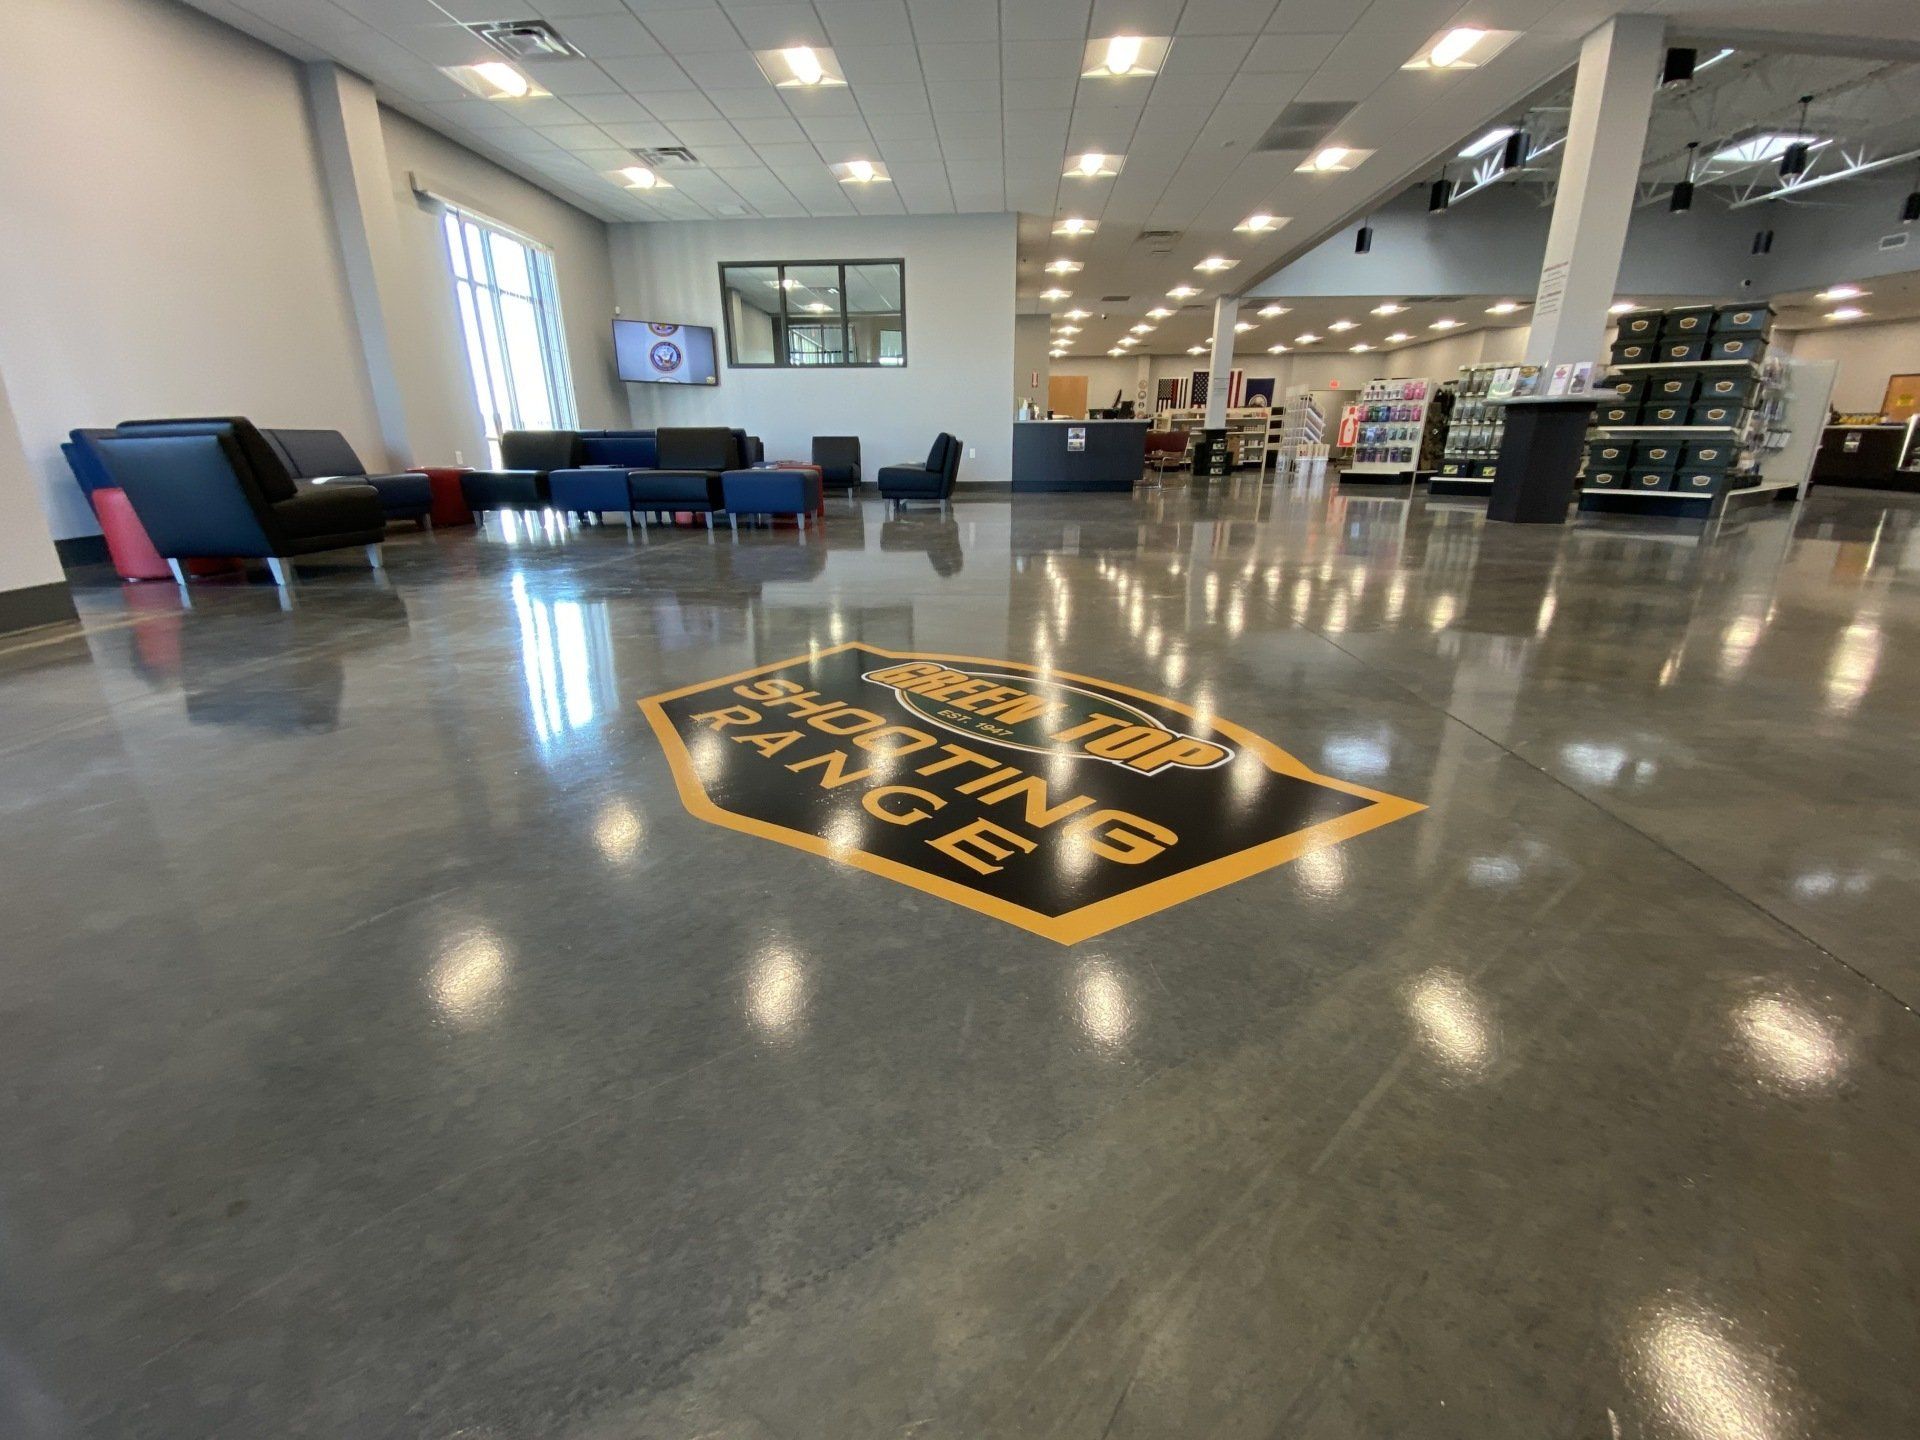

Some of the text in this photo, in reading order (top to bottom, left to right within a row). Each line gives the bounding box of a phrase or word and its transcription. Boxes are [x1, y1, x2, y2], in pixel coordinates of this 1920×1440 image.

[733, 678, 1179, 867] SHOOTING
[868, 663, 1225, 771] GREEN TOP
[937, 709, 1015, 736] EST. 1947
[689, 704, 1040, 876] RANGE
